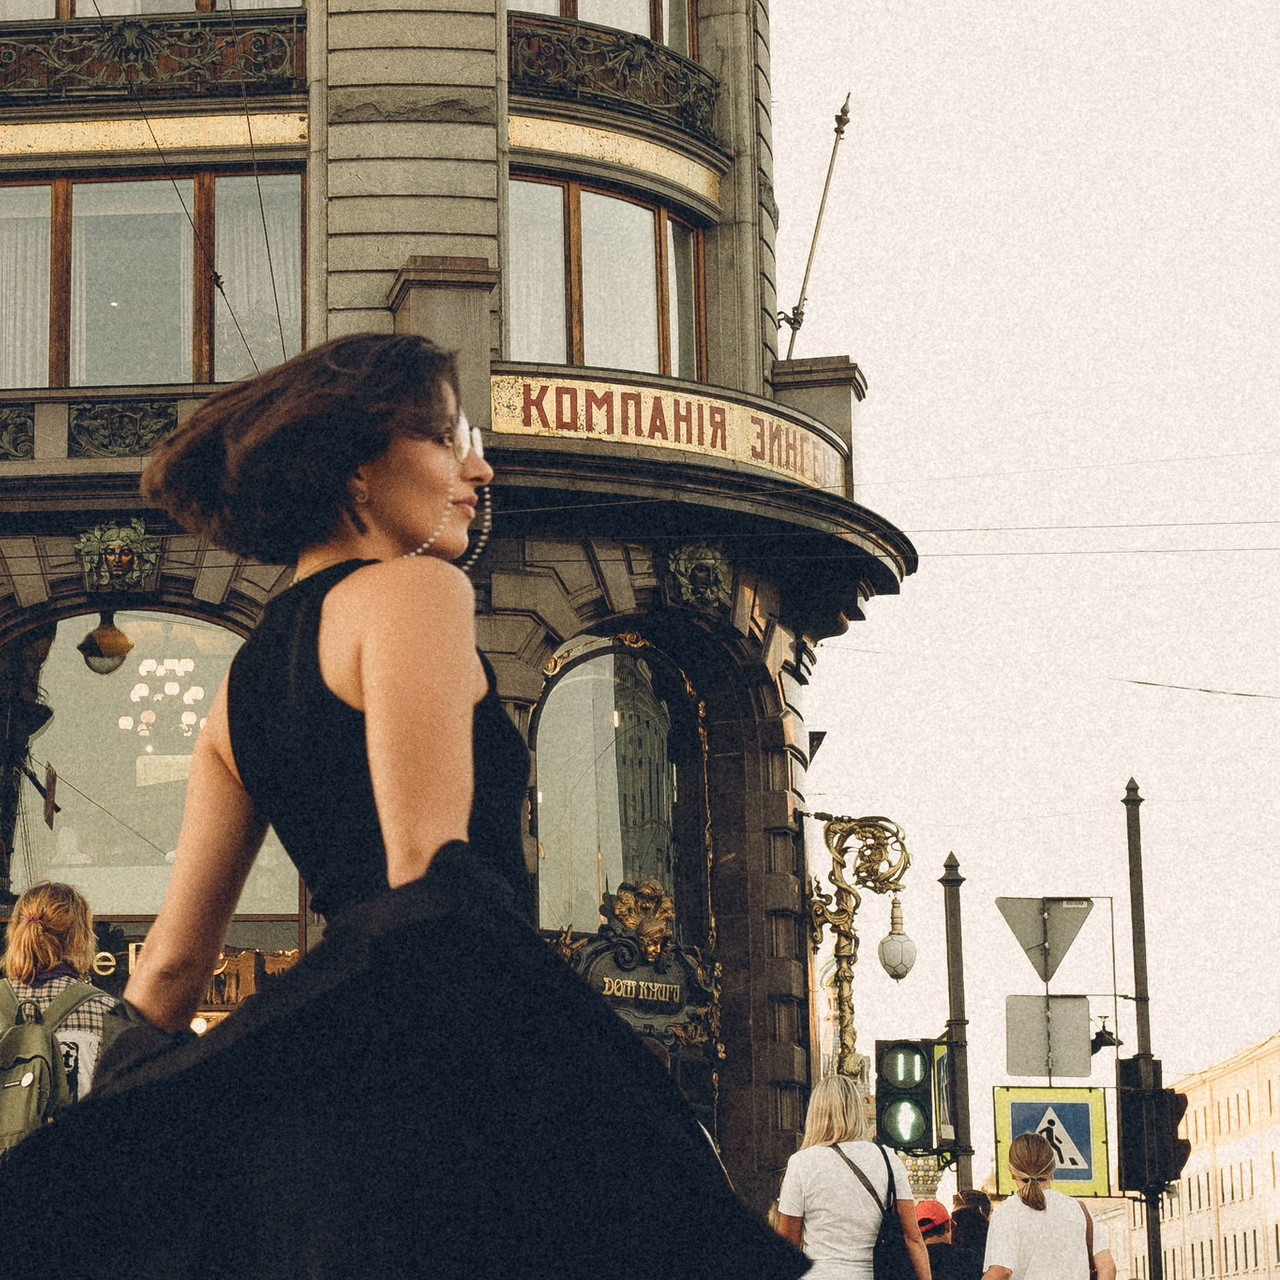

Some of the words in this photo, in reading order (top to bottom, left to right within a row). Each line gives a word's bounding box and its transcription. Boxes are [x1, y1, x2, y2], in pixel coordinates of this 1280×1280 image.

[522, 383, 727, 451] КОМПАНІЯ
[750, 414, 839, 490] ЗИНГЕР
[897, 1053, 921, 1081] 11
